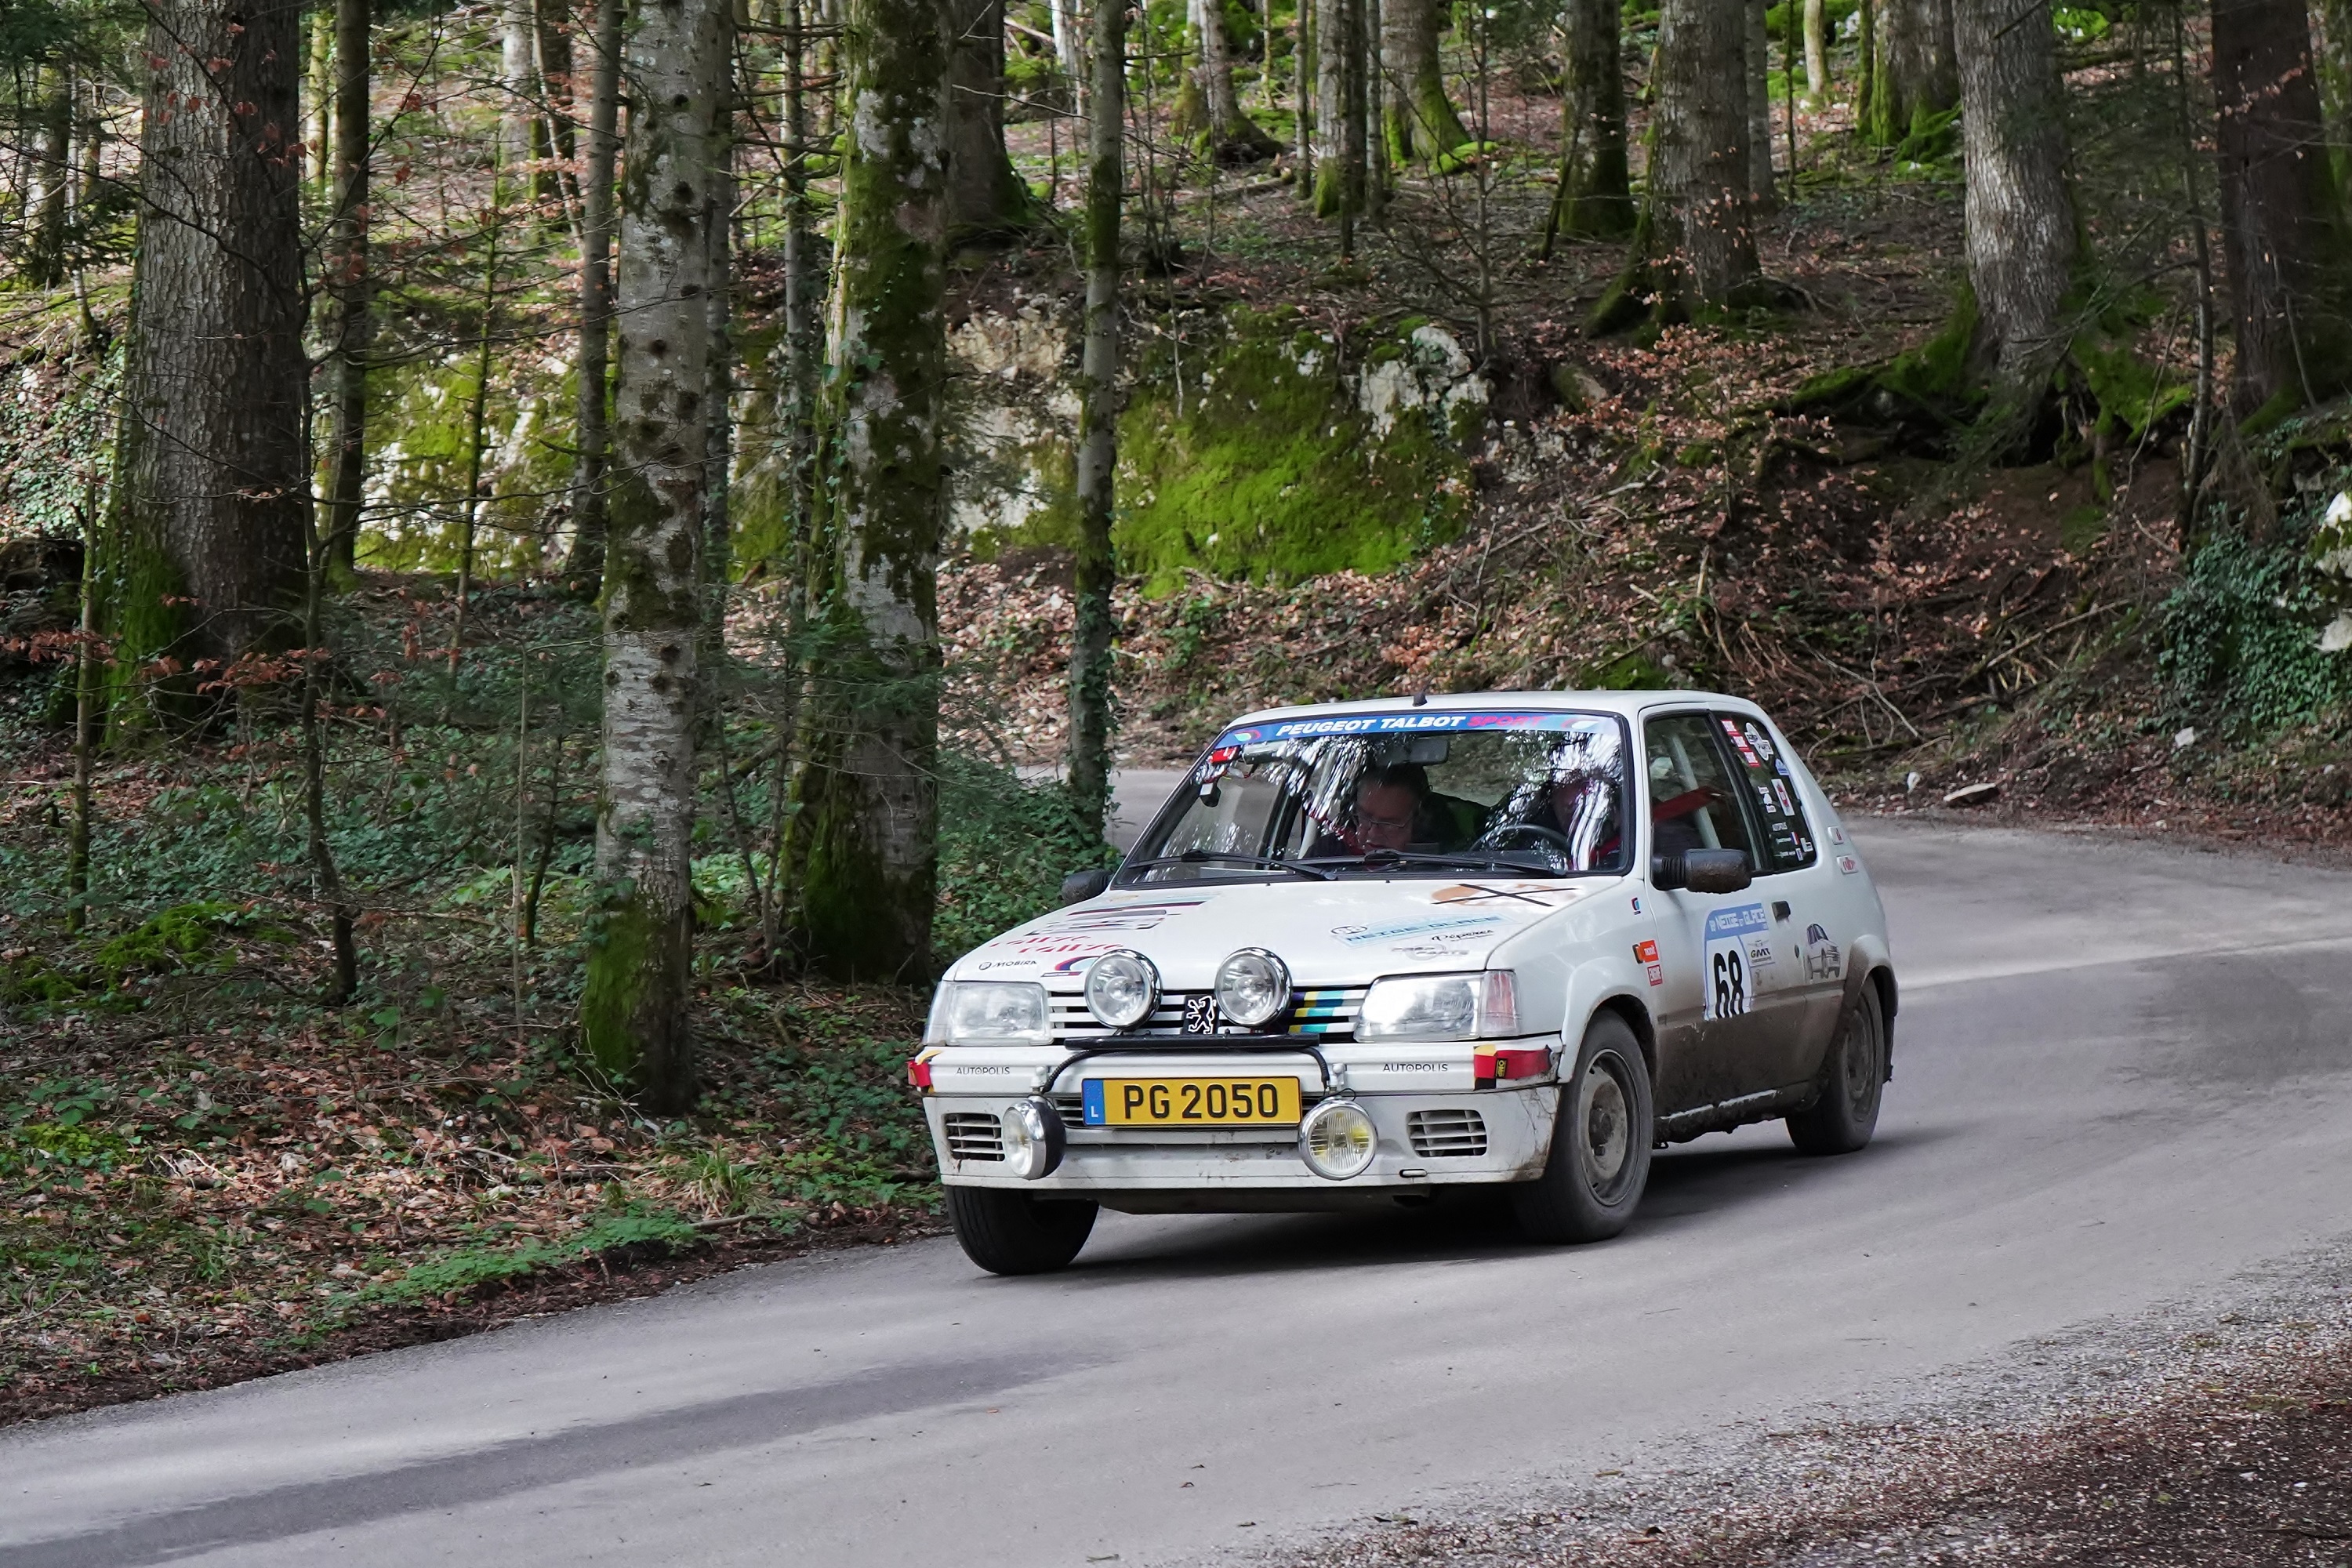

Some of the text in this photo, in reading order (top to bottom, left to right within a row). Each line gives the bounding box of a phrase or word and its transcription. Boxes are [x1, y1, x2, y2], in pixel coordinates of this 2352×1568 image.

[1276, 715, 1546, 736] PEUGEOT TALBOT SPORT
[1751, 947, 1771, 958] GMT
[1714, 949, 1744, 1018] 68
[956, 1066, 1011, 1075] AUTOPOLIS
[1382, 1063, 1449, 1073] AUTOPOLIS
[1123, 1083, 1279, 1120] PG 2050
[1091, 1105, 1099, 1118] L
